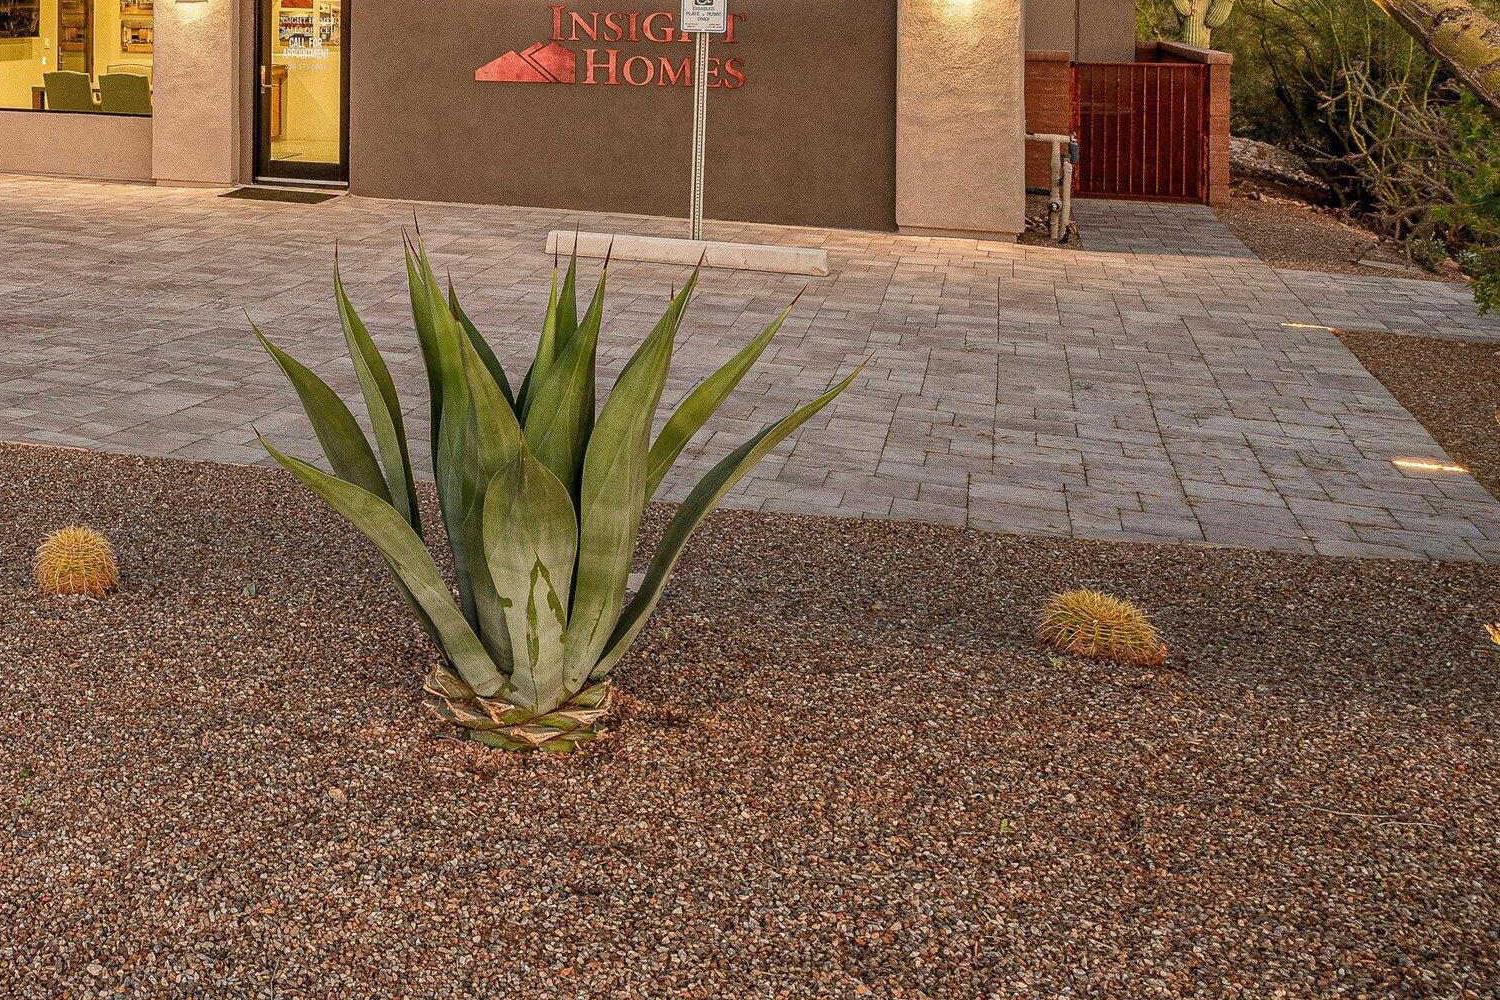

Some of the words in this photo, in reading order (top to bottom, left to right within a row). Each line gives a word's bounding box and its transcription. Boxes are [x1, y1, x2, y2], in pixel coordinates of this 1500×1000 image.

[277, 16, 306, 24] NSIGHT
[548, 4, 745, 43] INSIGT
[282, 26, 303, 34] SALES
[304, 26, 331, 34] OFCE
[289, 36, 306, 49] CALL
[308, 36, 324, 49] FOR
[282, 48, 330, 59] APPOINTMENT
[582, 49, 746, 88] HOMES
